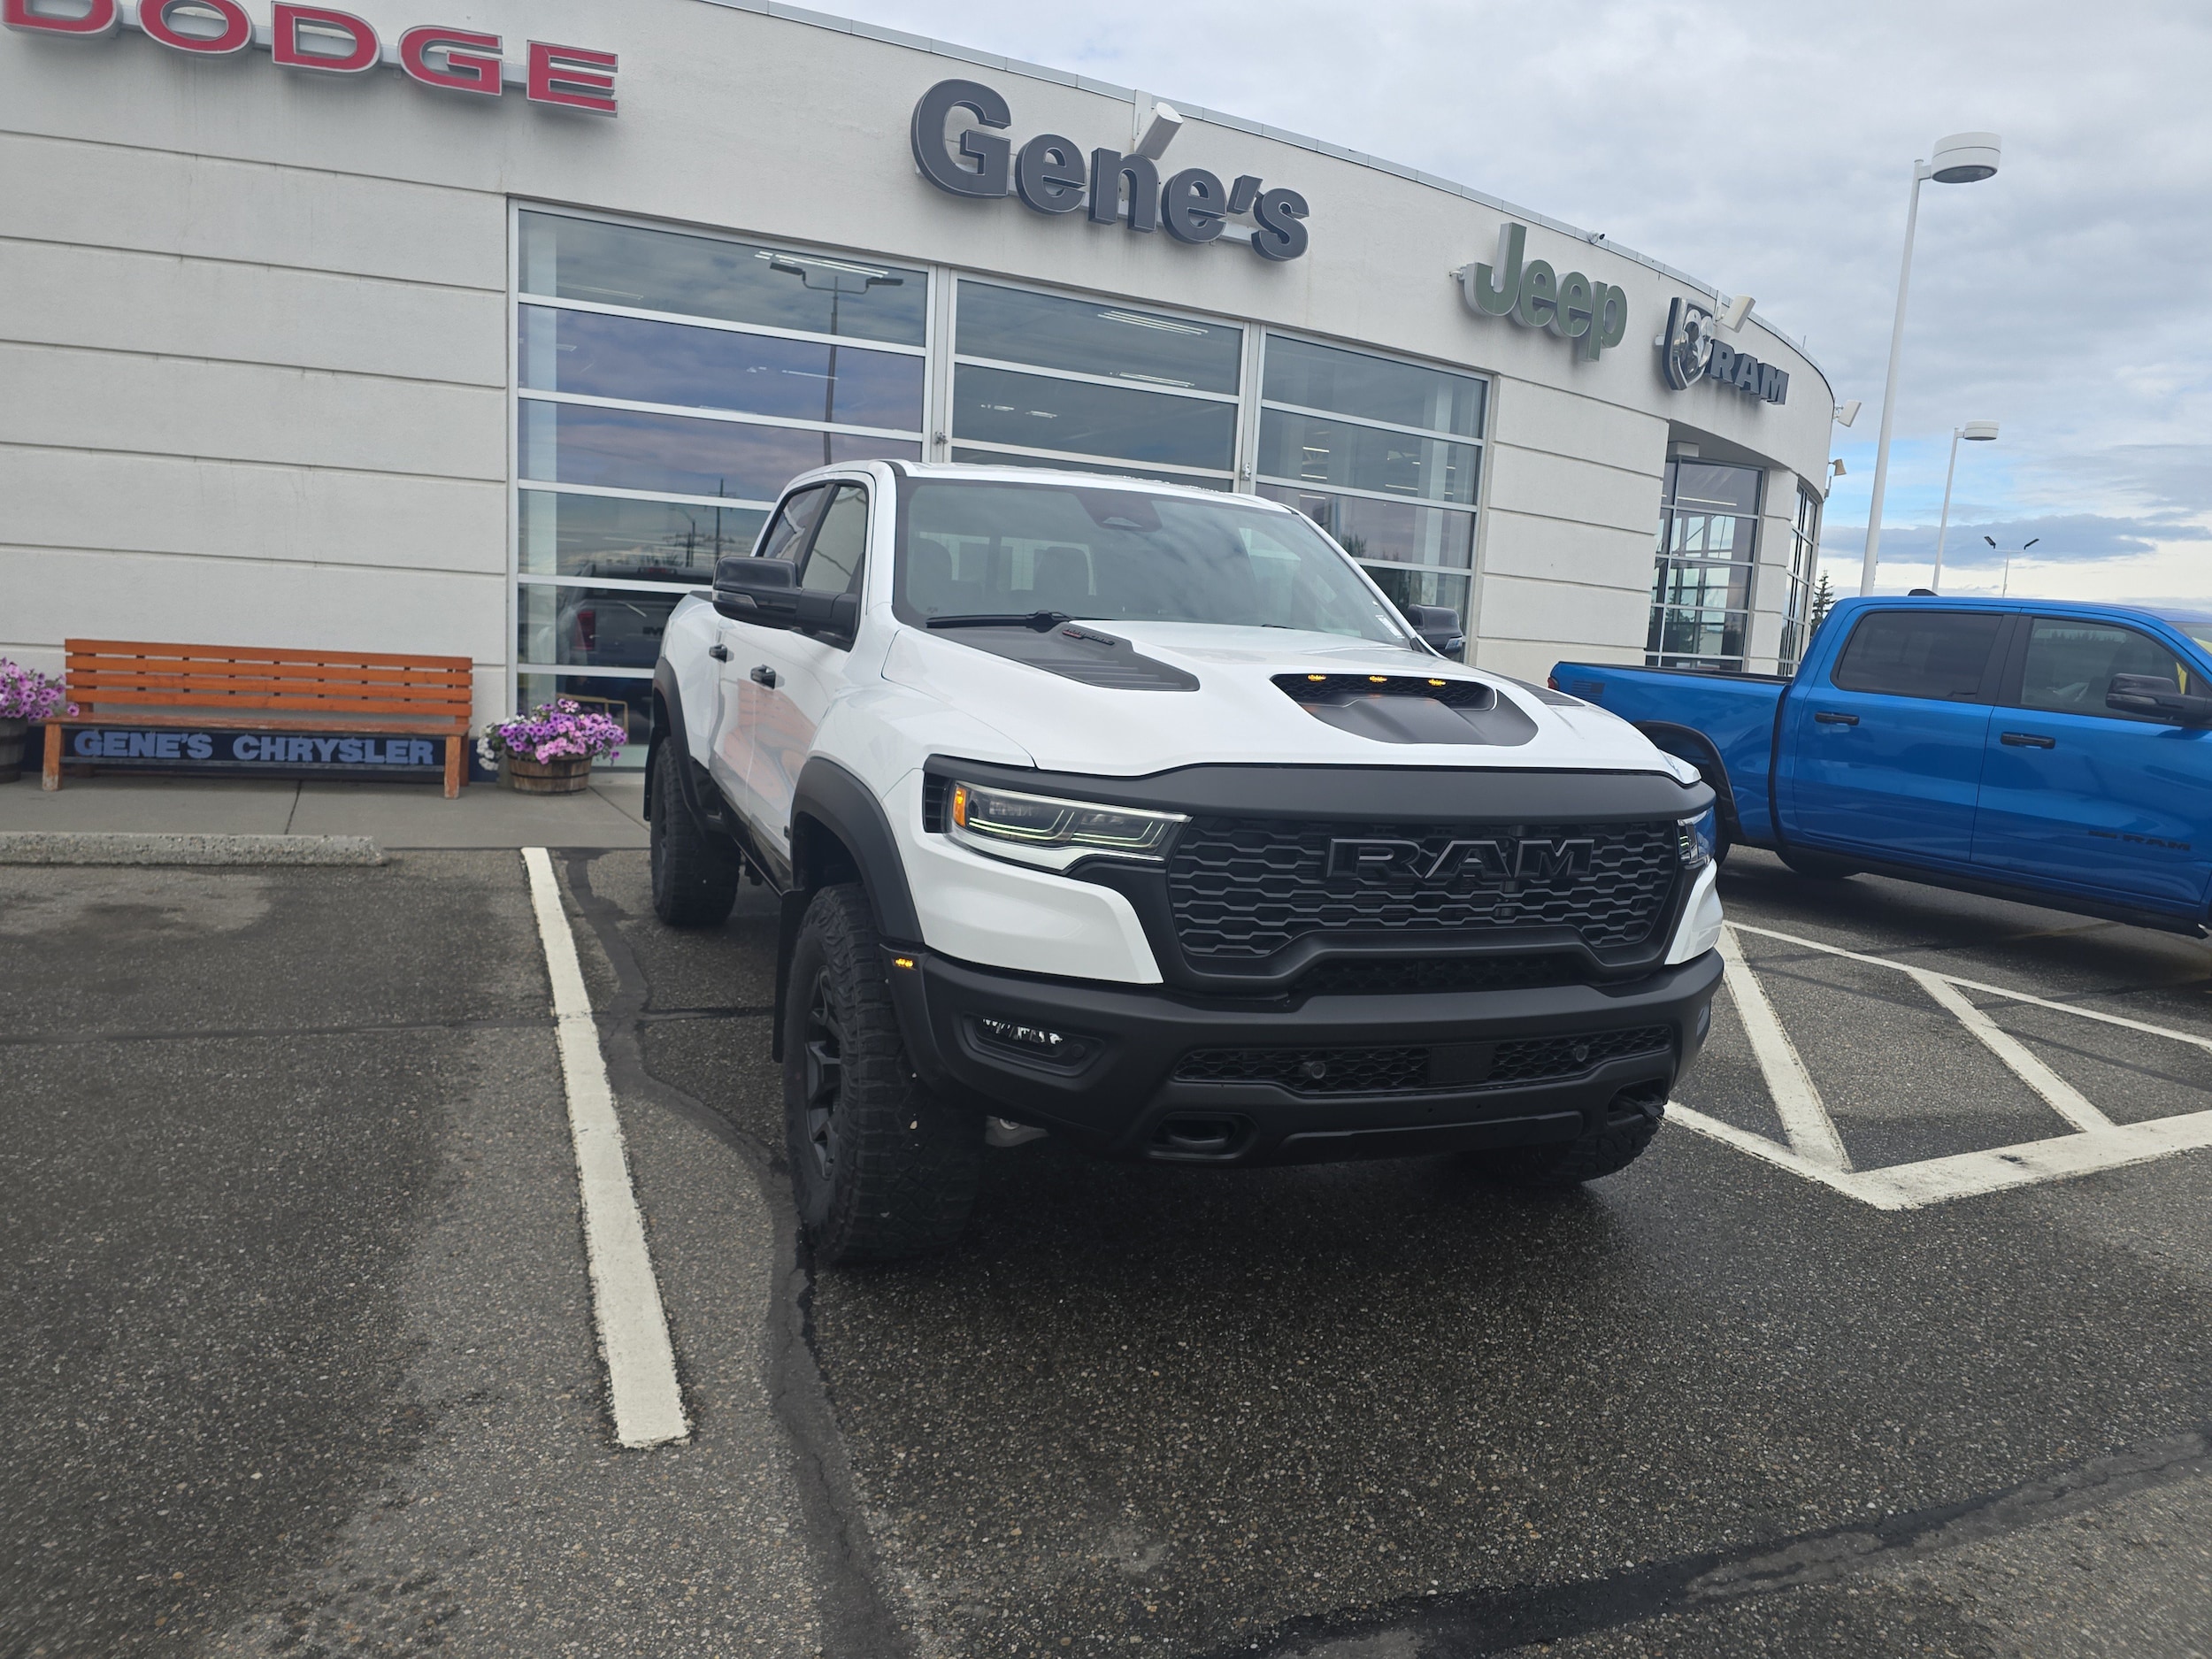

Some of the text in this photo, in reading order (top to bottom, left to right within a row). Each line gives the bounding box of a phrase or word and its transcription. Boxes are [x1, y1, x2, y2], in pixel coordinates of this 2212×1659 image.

[911, 79, 1310, 261] Gene's
[1464, 222, 1628, 363] Jeep
[1708, 338, 1790, 405] RAM
[73, 729, 434, 765] GENE'S CHRYSLER
[1326, 838, 1595, 879] RAM
